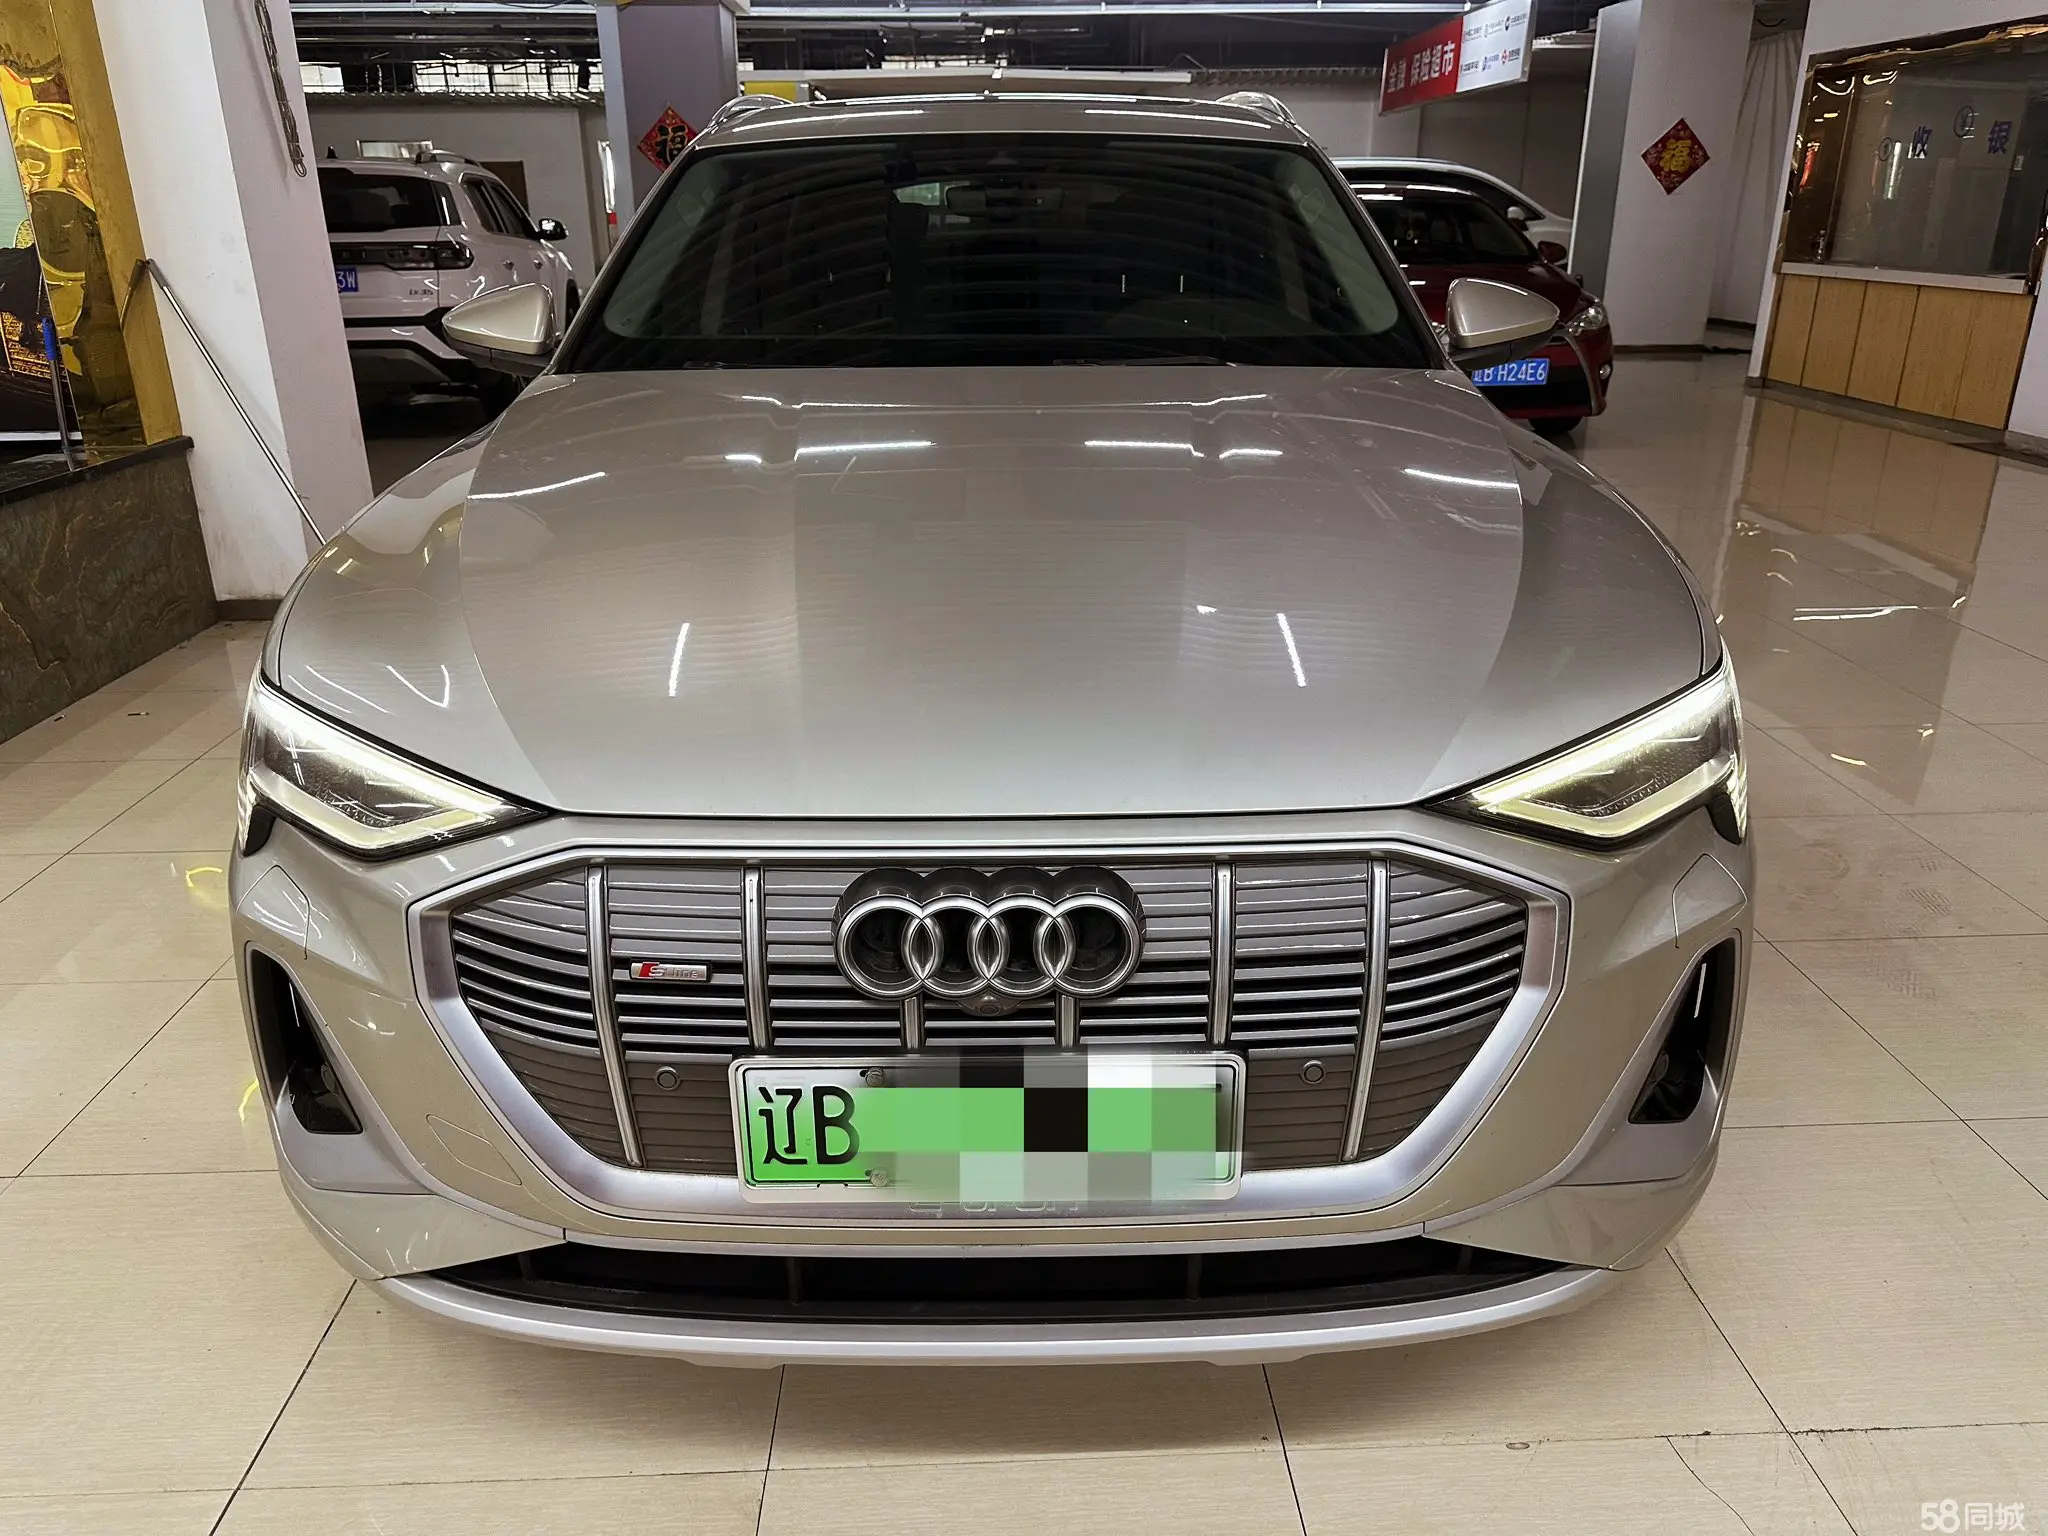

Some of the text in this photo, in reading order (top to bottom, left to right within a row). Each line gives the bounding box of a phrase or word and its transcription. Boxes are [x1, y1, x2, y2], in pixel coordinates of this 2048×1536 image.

[1410, 40, 1456, 87] 保险超市
[1659, 138, 1692, 173] 福
[1912, 120, 2012, 158] 收 银
[758, 1085, 860, 1165] 辽B
